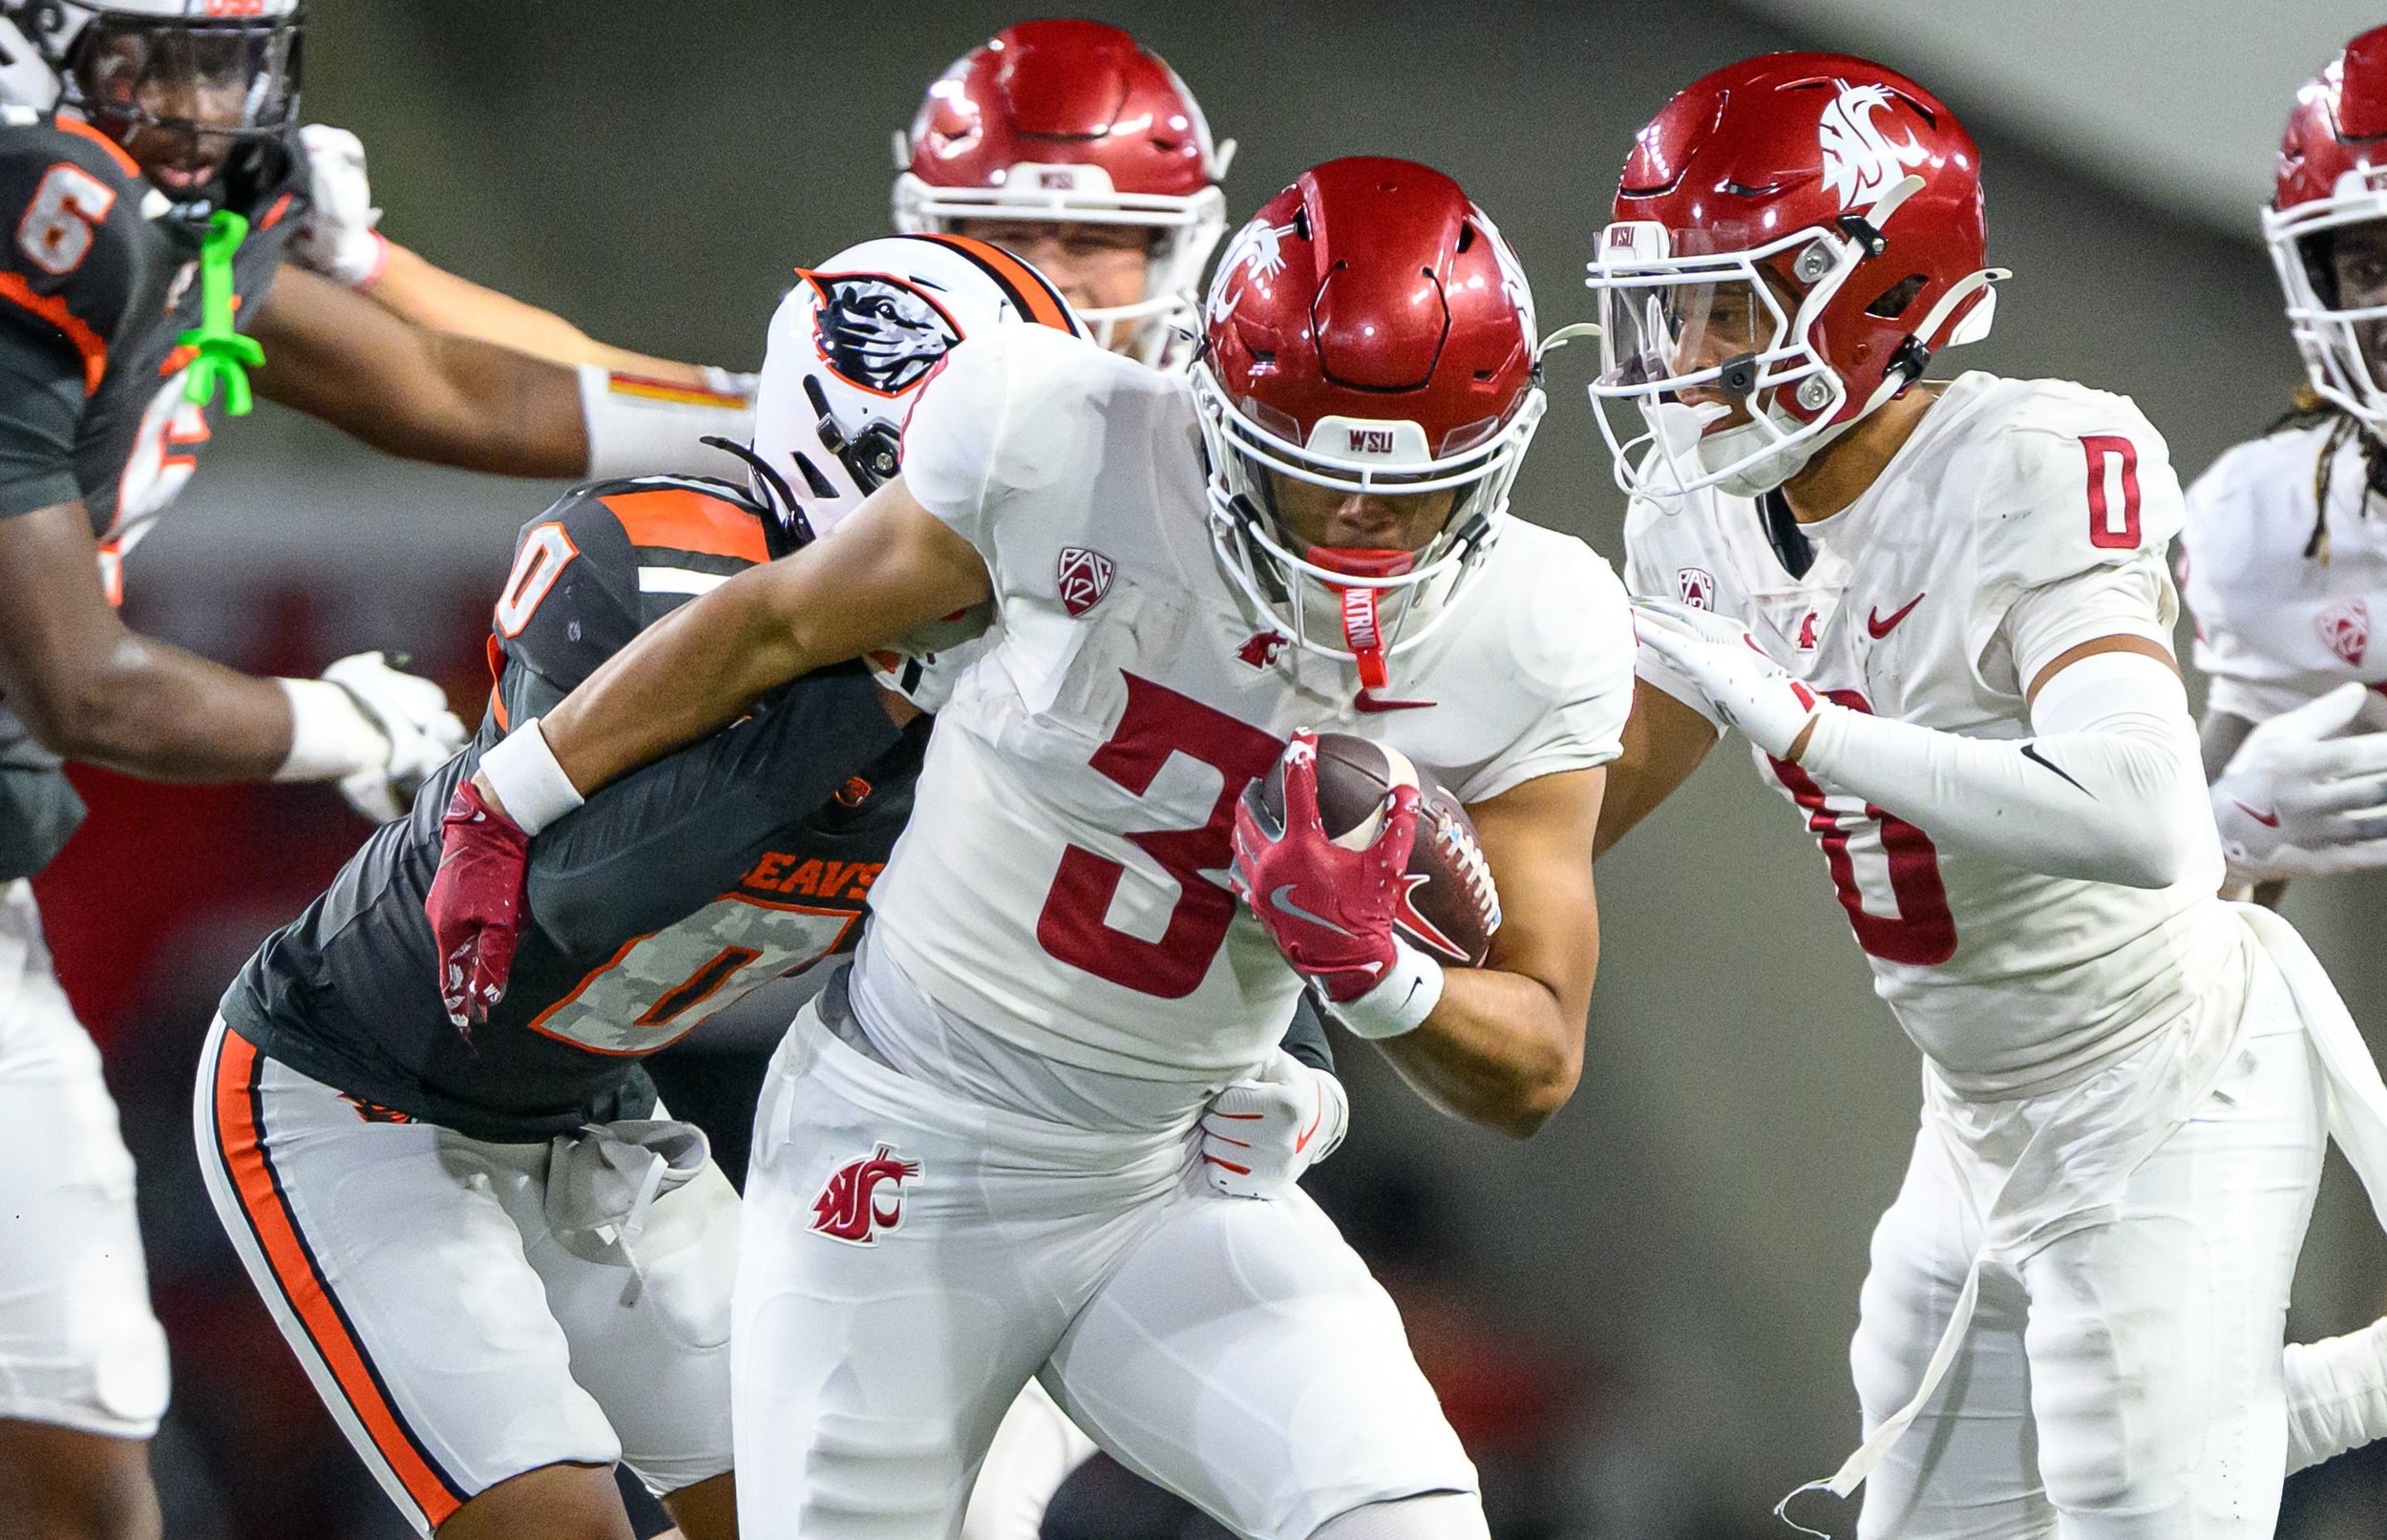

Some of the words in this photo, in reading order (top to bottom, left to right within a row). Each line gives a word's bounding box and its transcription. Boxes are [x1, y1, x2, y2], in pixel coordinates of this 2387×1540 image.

[16, 161, 116, 275] 6
[1610, 225, 1636, 247] WSU
[1348, 429, 1393, 454] WSU
[2078, 435, 2142, 550] 0
[494, 521, 581, 640] 0
[1058, 548, 1112, 599] PAC
[1064, 577, 1095, 606] 12
[1037, 667, 1287, 999] 3
[741, 851, 886, 900] EAVS
[528, 892, 863, 1056] 0
